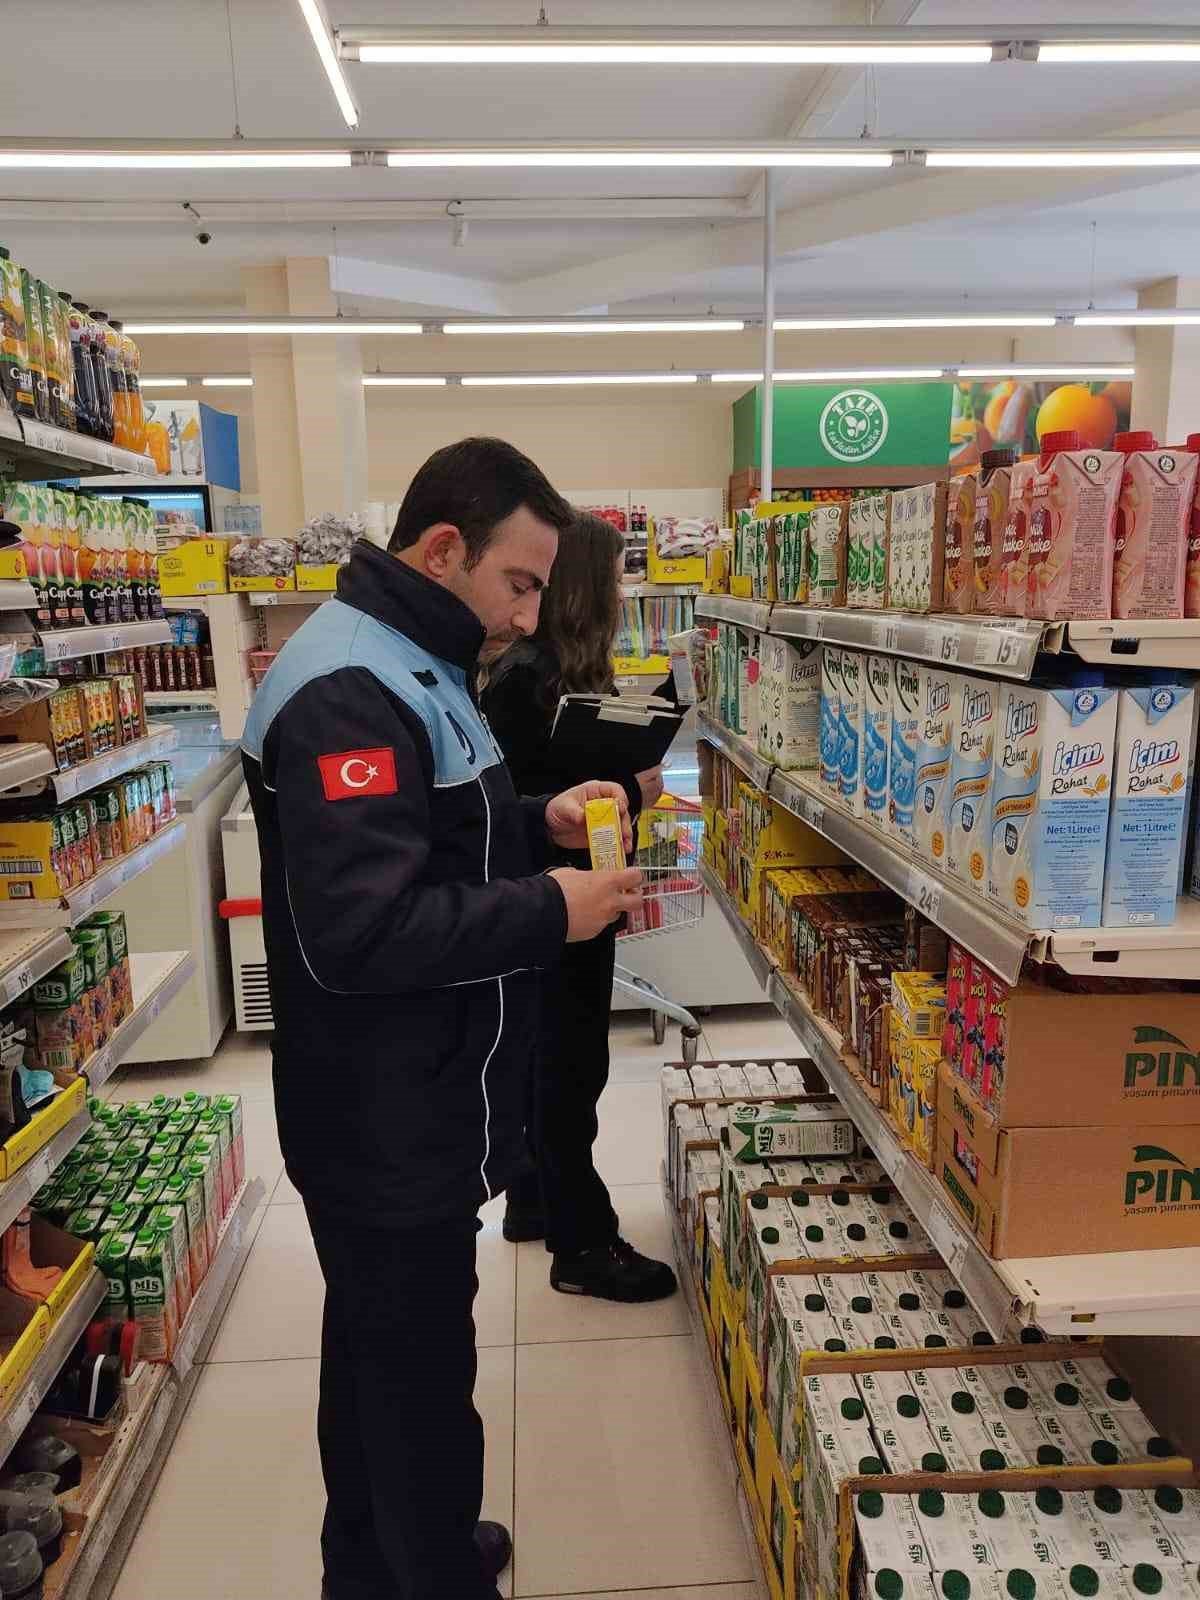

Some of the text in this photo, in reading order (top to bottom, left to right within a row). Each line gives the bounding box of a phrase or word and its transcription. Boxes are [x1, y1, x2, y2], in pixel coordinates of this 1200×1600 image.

[831, 396, 878, 417] TAZE
[1002, 745, 1028, 767] Rahat
[1051, 776, 1087, 795] Rahat
[1128, 774, 1163, 794] Rahat
[919, 886, 933, 911] 24
